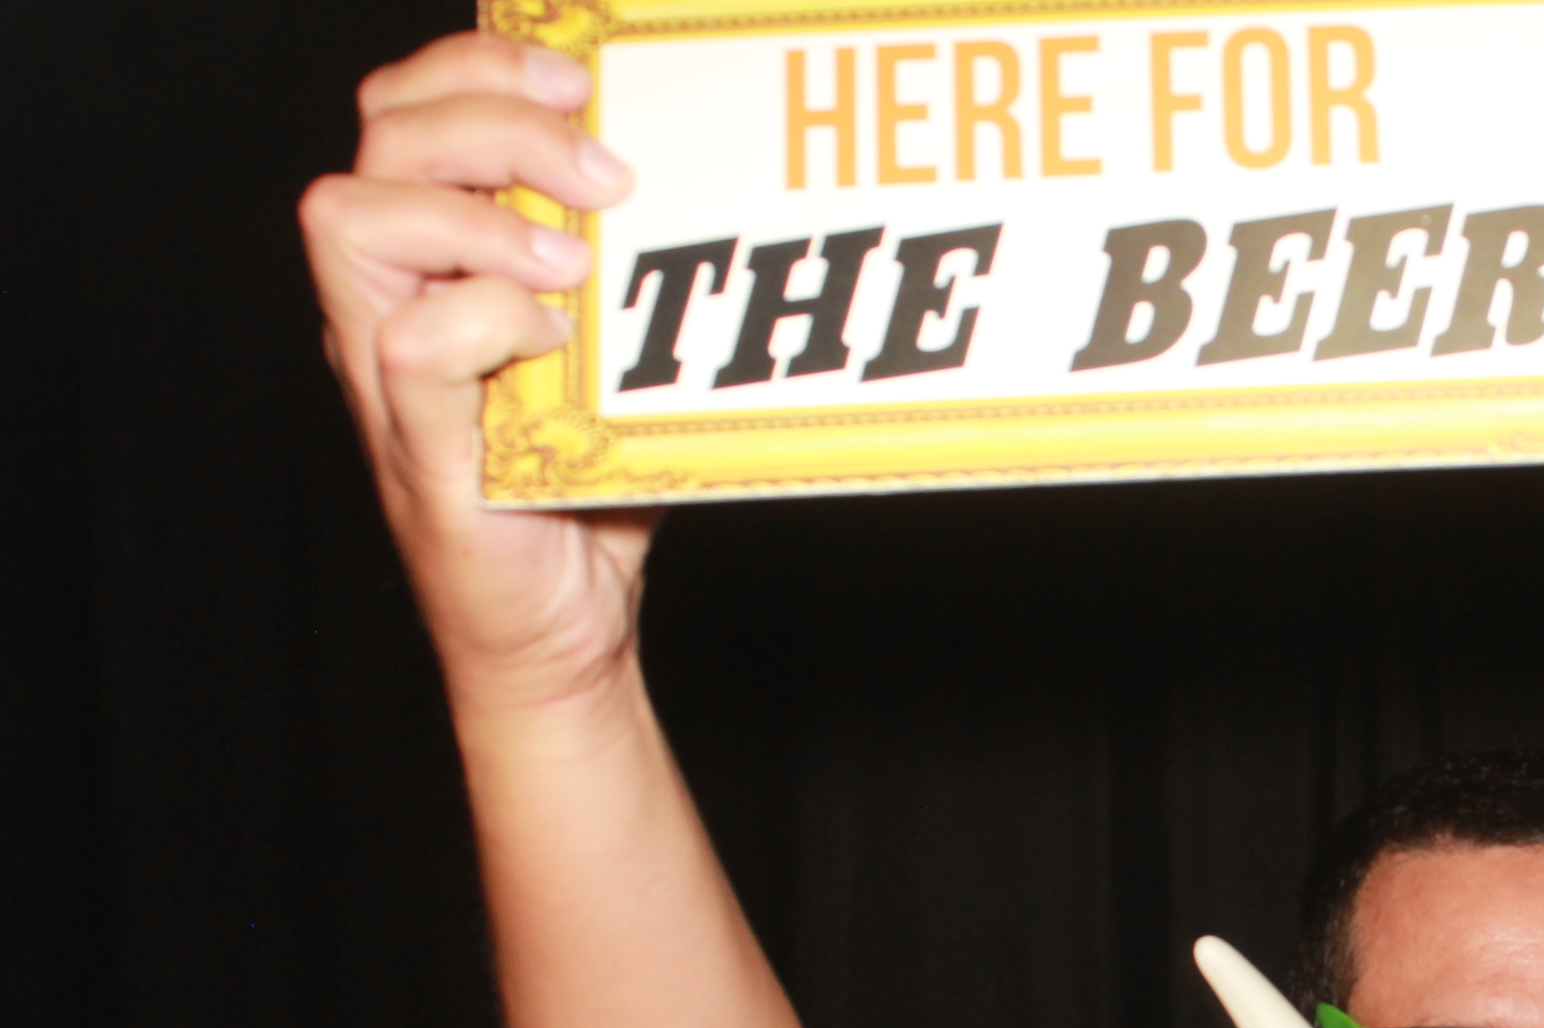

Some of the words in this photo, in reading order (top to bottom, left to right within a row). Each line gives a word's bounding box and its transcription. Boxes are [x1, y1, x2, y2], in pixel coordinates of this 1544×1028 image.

[783, 35, 1103, 190] HERE
[1149, 24, 1380, 172] FOR
[617, 222, 1003, 393] THE
